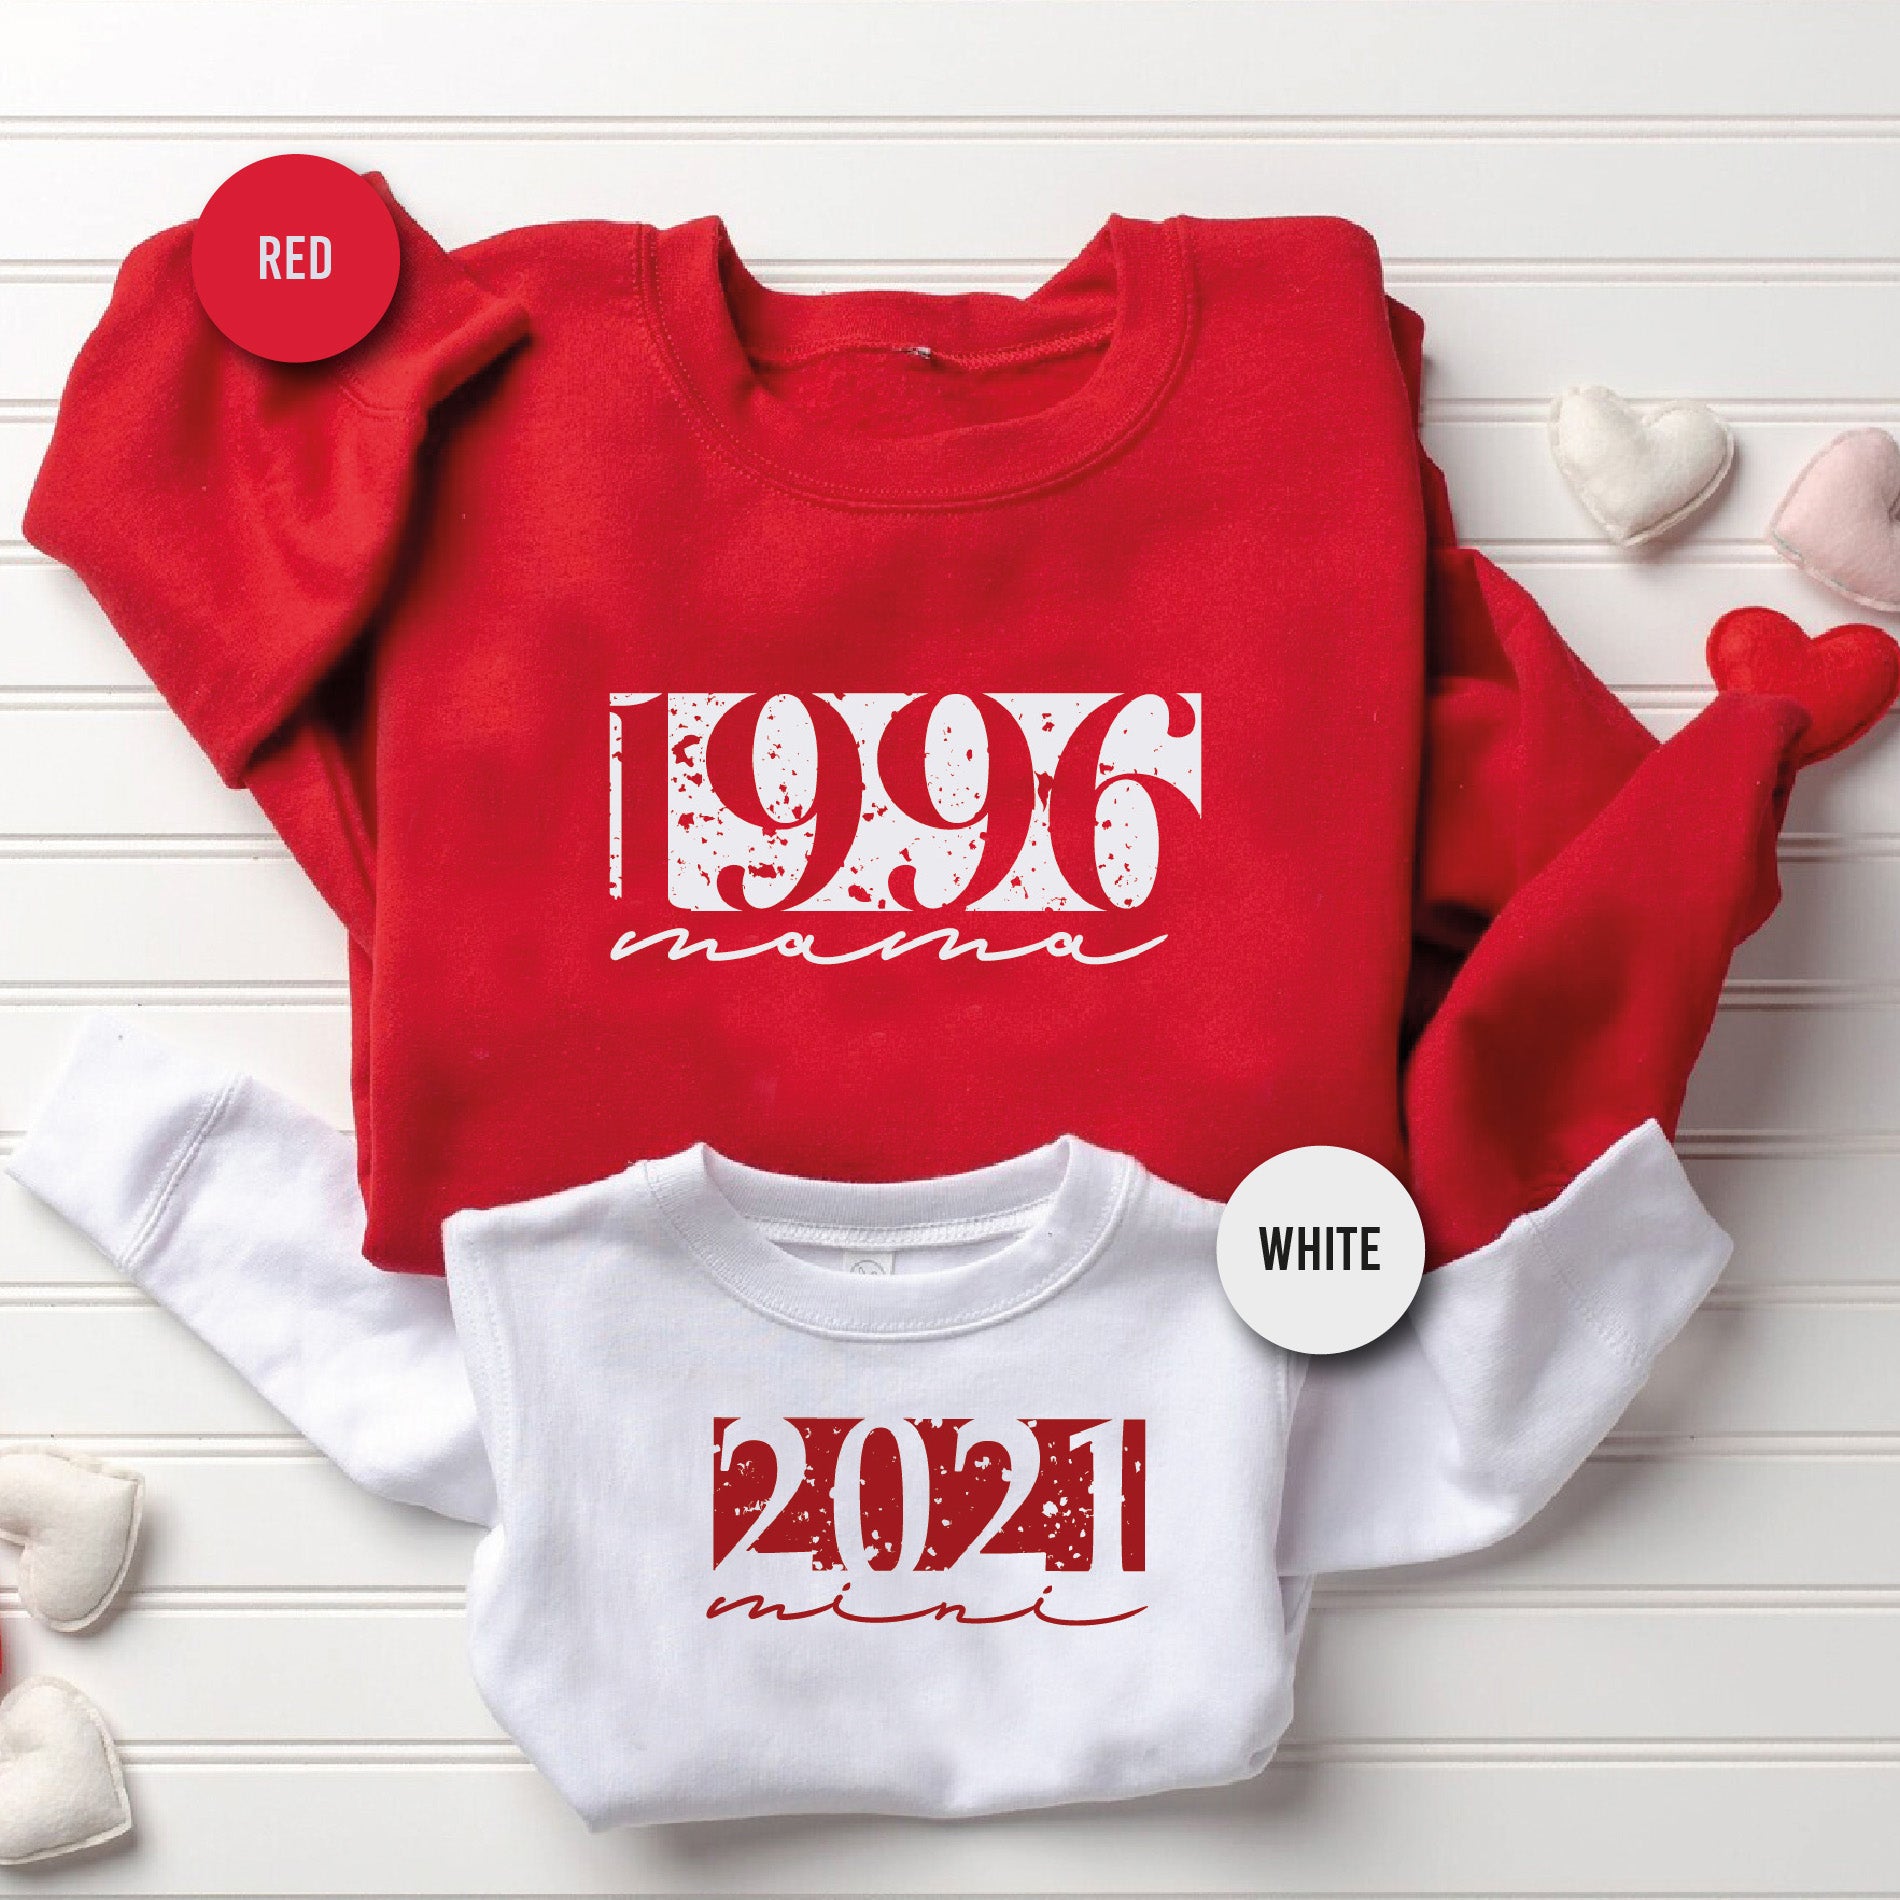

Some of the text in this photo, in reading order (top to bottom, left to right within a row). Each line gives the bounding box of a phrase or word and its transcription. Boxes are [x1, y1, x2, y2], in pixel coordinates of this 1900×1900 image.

[609, 692, 1202, 912] 1996
[609, 927, 1168, 965] mama
[712, 1416, 1147, 1573] 2021
[705, 1582, 1148, 1627] mini
